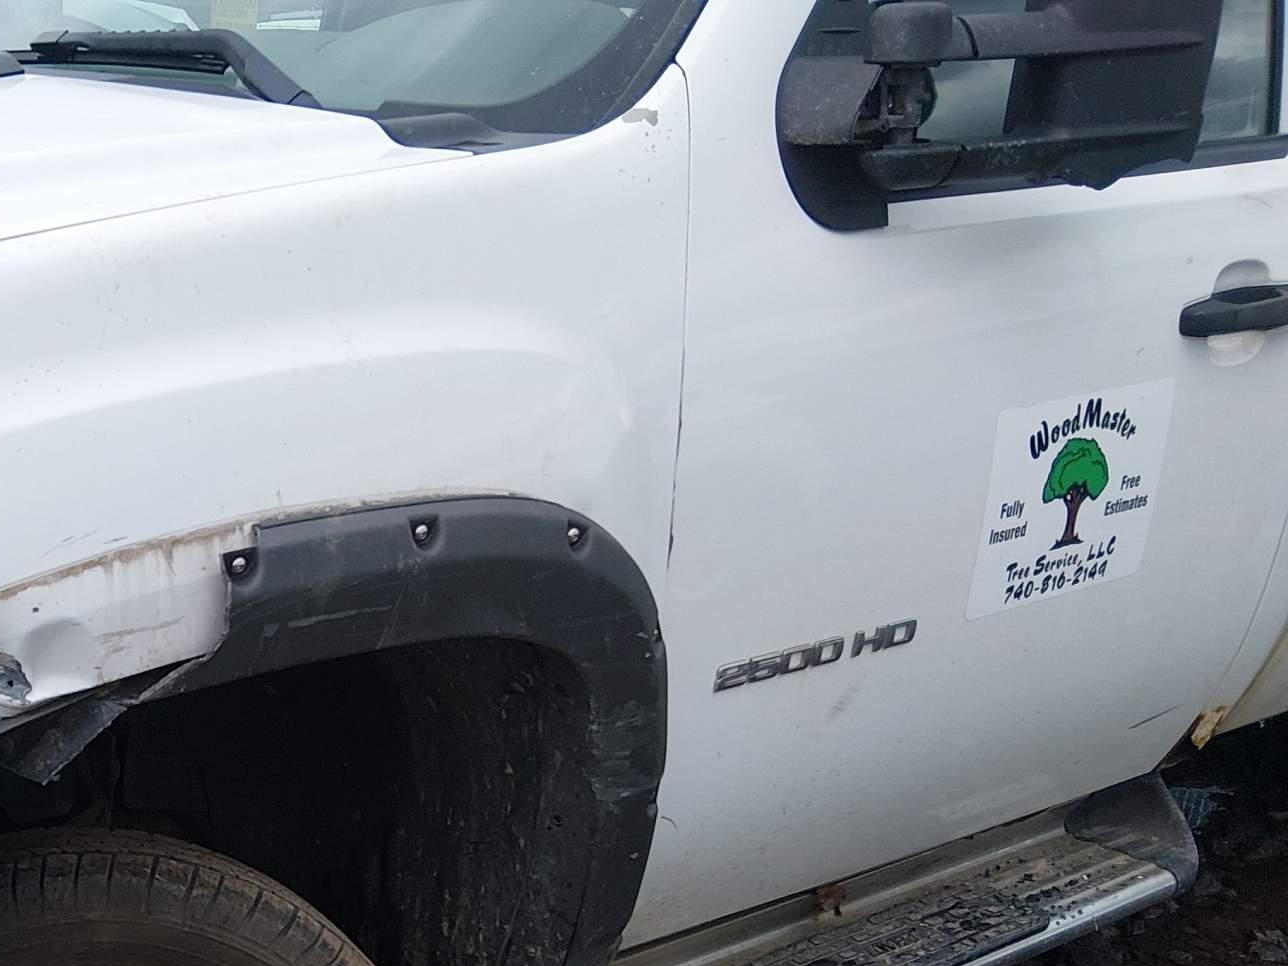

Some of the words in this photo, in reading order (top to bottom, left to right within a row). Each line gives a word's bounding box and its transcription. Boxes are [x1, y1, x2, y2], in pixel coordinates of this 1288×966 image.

[1120, 474, 1141, 491] Free
[1000, 501, 1025, 520] Fully
[1103, 494, 1149, 516] Estimates
[988, 521, 1028, 545] Insured
[1006, 562, 1031, 582] Tree
[1033, 554, 1083, 576] Service,
[1086, 536, 1116, 562] LLC
[713, 637, 845, 693] 2500
[850, 616, 918, 658] HD
